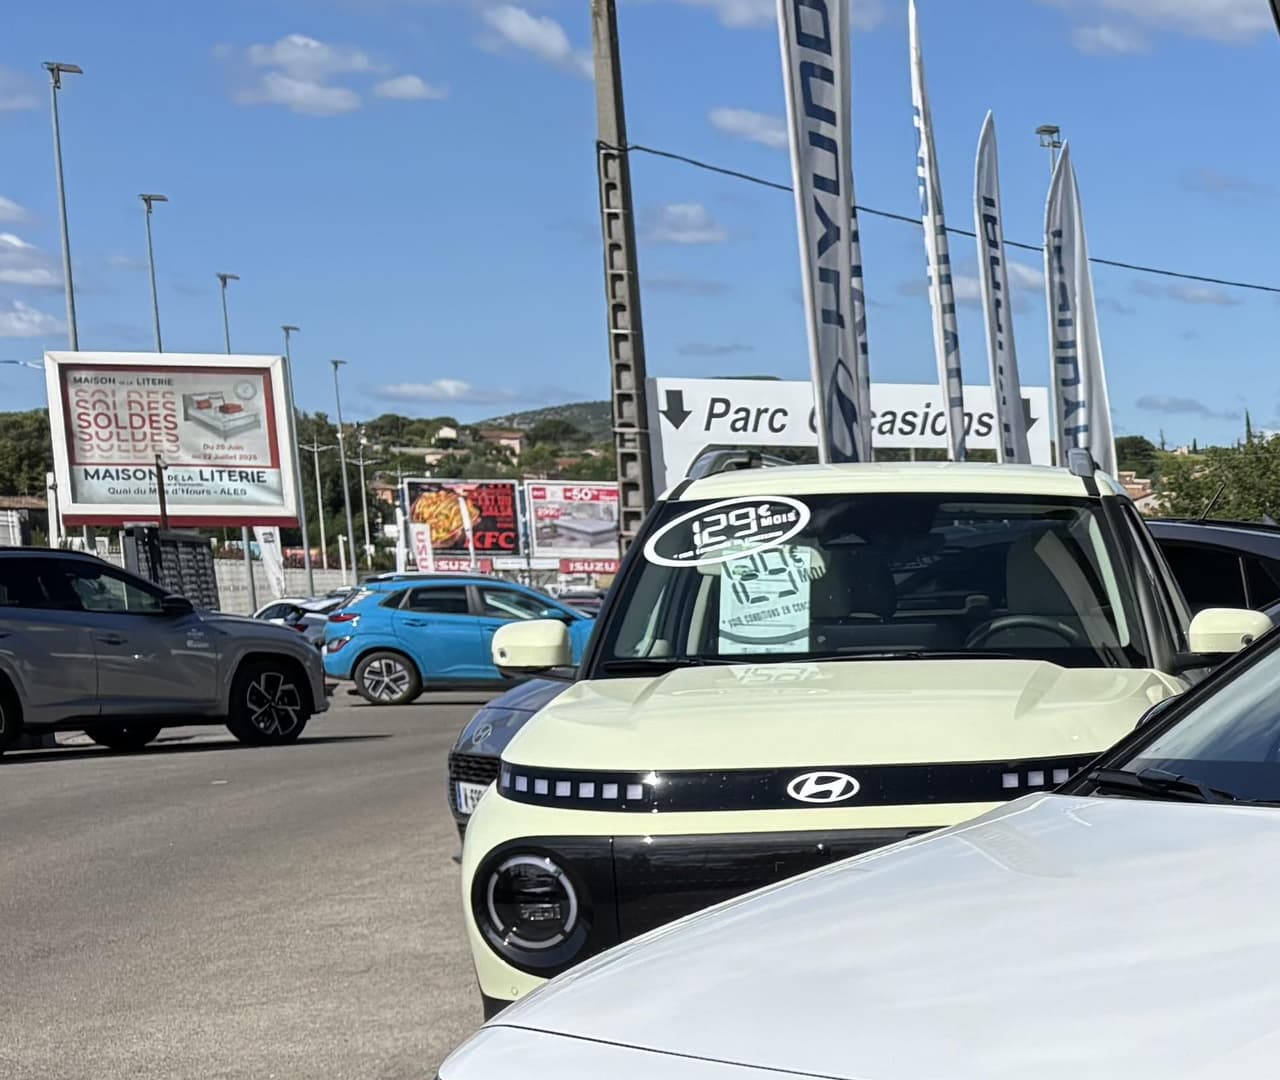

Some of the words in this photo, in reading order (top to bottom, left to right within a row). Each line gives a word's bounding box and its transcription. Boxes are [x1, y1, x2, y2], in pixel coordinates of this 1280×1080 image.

[73, 376, 116, 386] MAISON
[136, 377, 175, 386] LITERIE
[77, 412, 179, 431] SOLDES
[704, 397, 789, 434] Parc
[84, 468, 158, 481] MAISON
[199, 469, 267, 483] LITERIE
[108, 487, 131, 495] Quai
[133, 487, 146, 495] du
[464, 531, 516, 548] KFC
[569, 561, 615, 571] ISUZU
